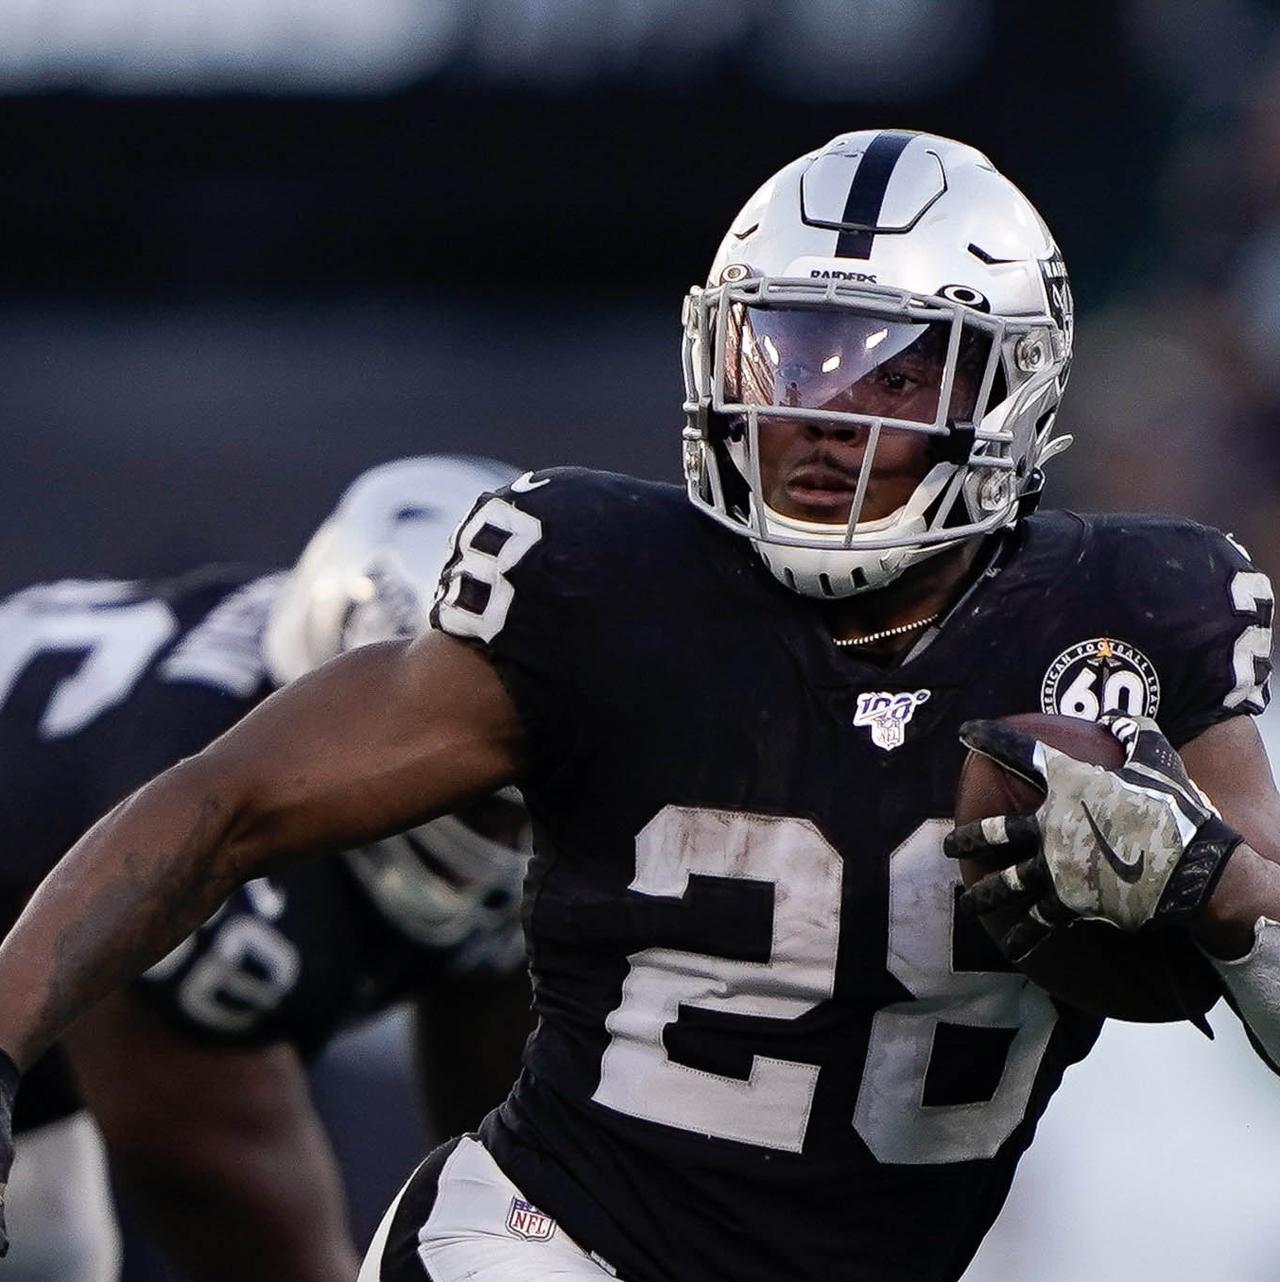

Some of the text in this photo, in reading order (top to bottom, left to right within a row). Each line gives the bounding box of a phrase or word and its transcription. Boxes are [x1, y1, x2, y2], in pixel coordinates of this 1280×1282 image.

[1044, 654, 1072, 715] MERICAN
[1060, 667, 1144, 722] 60
[591, 804, 1060, 1165] 28
[512, 1210, 548, 1235] NFL
